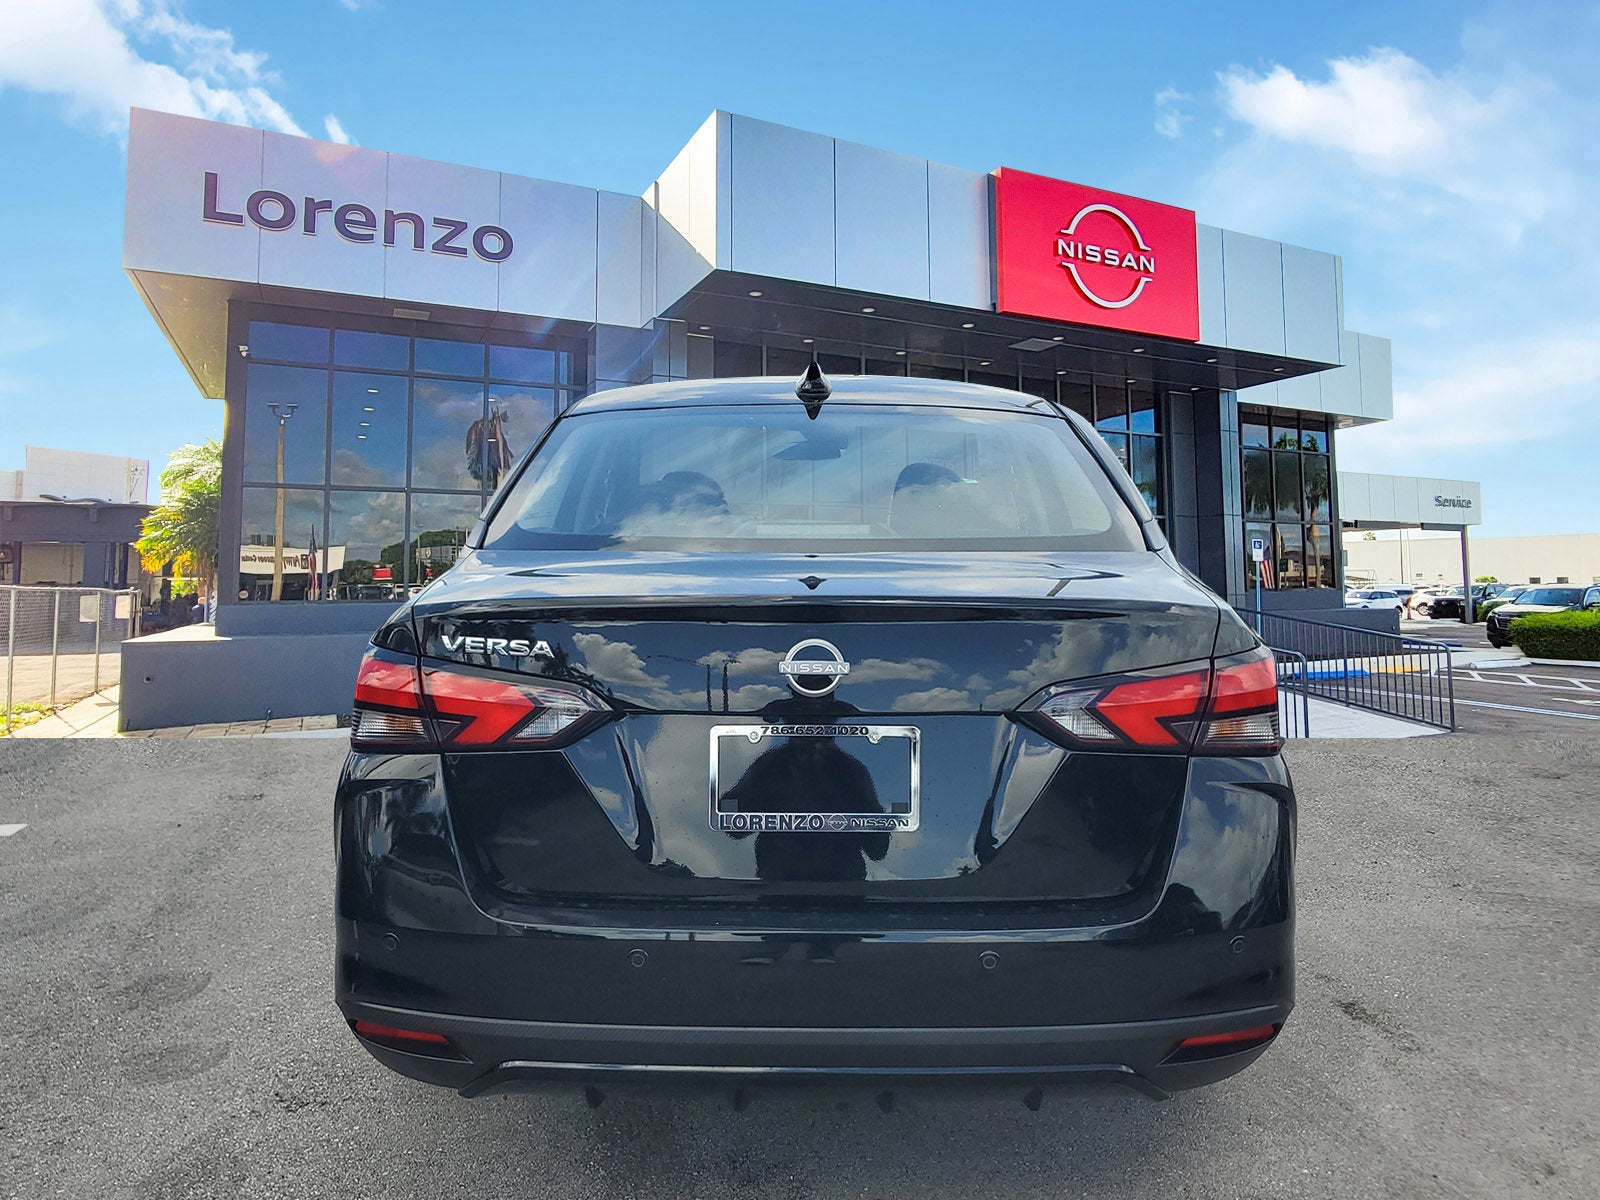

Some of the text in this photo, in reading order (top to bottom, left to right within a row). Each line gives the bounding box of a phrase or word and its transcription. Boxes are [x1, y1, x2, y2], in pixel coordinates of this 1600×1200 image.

[202, 171, 515, 262] Lorenzo
[1057, 238, 1155, 273] NISSAN
[1434, 495, 1472, 508] Service
[441, 635, 555, 659] VERSA
[780, 663, 848, 673] NISSAN
[719, 814, 909, 830] LORENZO NISSAN
